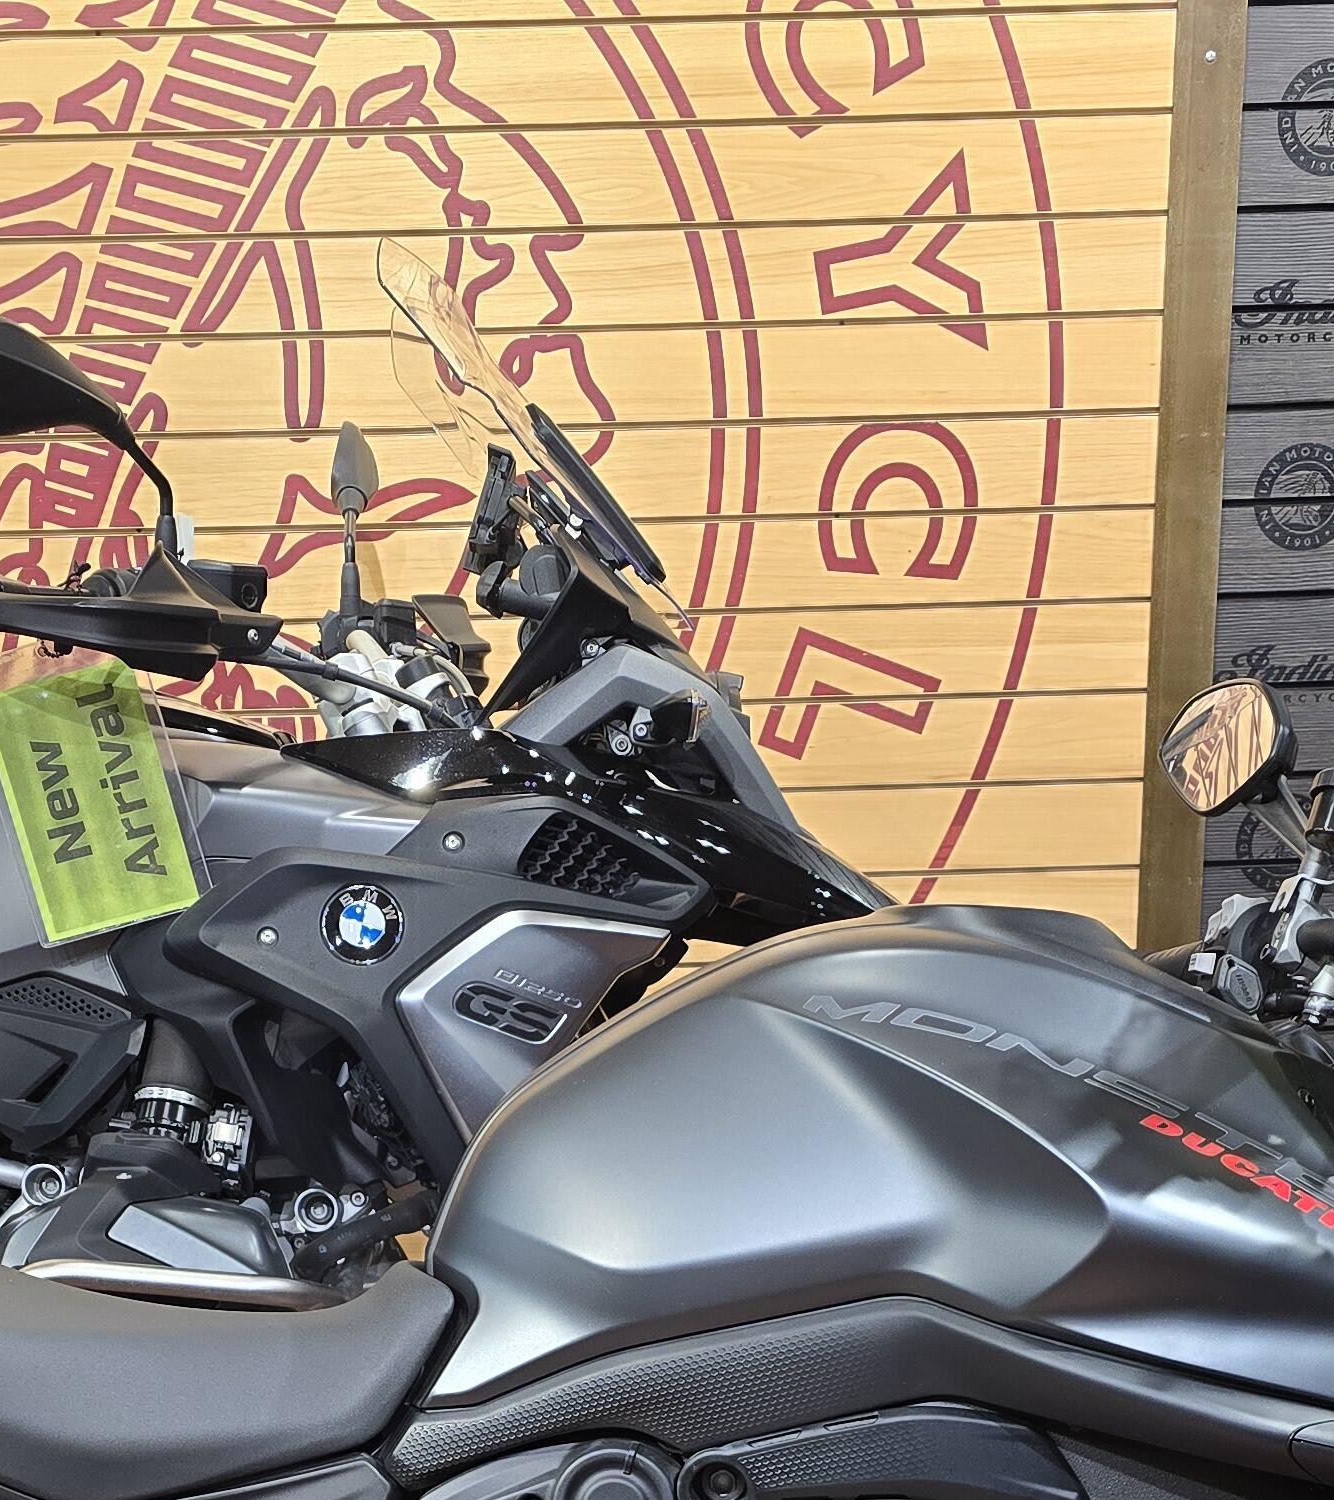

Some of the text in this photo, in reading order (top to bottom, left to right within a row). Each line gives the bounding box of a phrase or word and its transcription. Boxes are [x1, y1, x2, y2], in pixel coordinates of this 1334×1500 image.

[1284, 535, 1321, 548] 1901
[31, 740, 92, 867] New
[73, 680, 167, 881] Arrival
[338, 886, 398, 922] BMW
[464, 991, 566, 1040] GS
